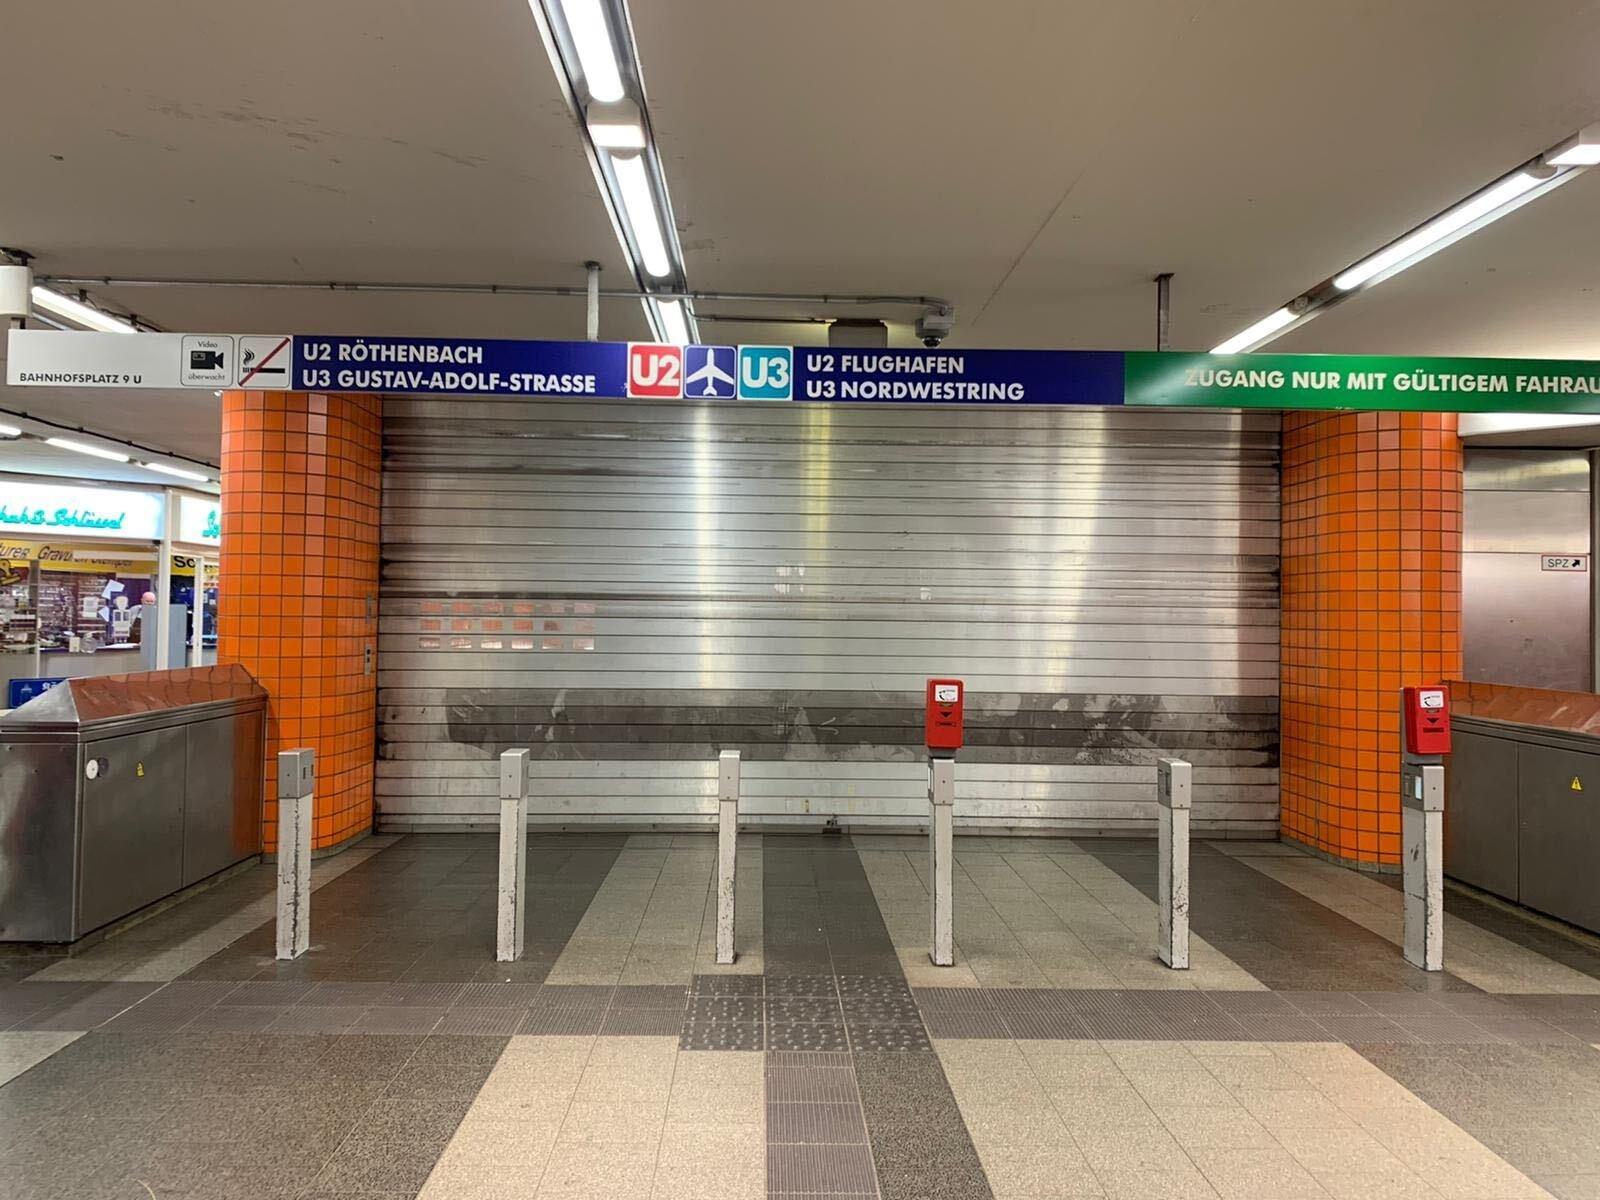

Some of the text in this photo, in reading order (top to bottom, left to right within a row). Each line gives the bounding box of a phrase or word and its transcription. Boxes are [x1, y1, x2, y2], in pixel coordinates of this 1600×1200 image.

[303, 340, 483, 364] U2 RÖTHENBACH
[632, 354, 681, 388] U2
[742, 357, 789, 388] U3
[807, 355, 964, 374] U2 FLUGHAFEN
[20, 373, 142, 384] BAHNHOFSPLATZ 9 U
[302, 370, 596, 393] U3 GUSTAV-ADOLF-STRASSE
[1184, 369, 1285, 388] ZUGANG
[1292, 371, 1341, 390] NUR
[1347, 372, 1387, 391] MIT
[1393, 369, 1509, 393] GÜLTIGEM
[807, 381, 1025, 400] U3 NORDWESTRING
[1548, 558, 1569, 568] SPZ
